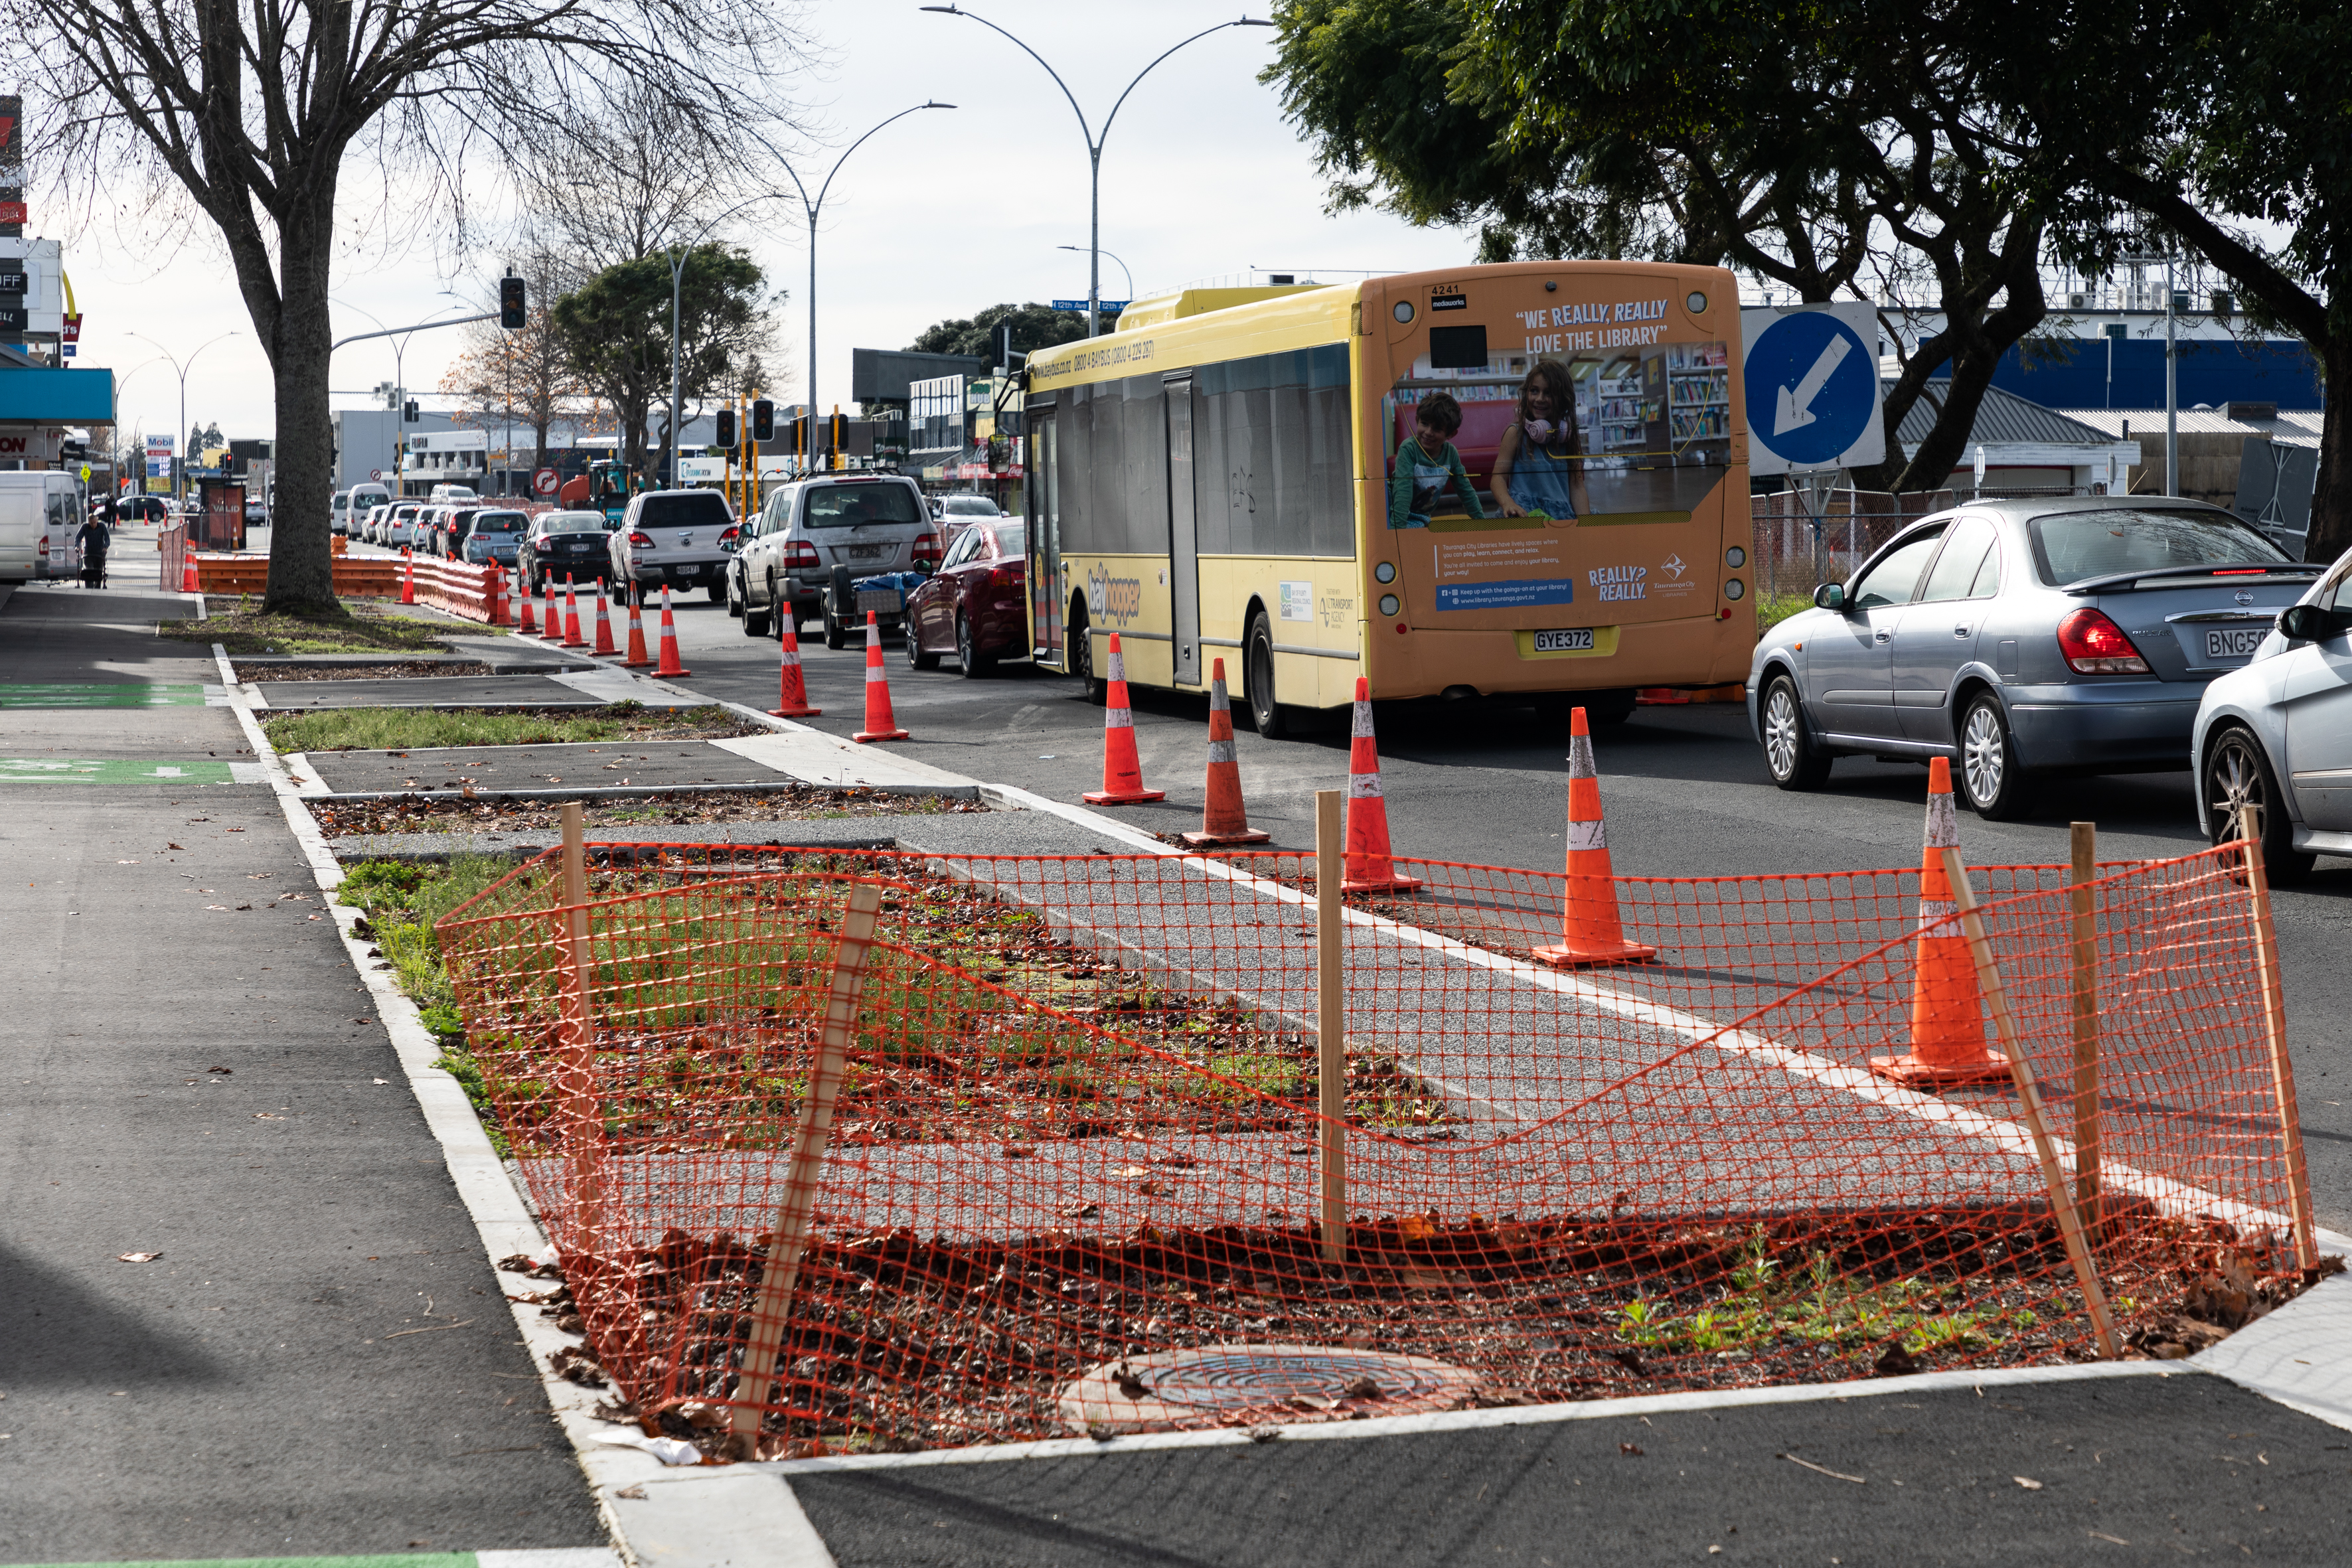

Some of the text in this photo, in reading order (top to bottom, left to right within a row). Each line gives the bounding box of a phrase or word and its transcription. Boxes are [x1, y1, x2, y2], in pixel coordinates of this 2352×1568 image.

[1432, 285, 1458, 295] 4241
[1516, 299, 1668, 329] “WE REALLY, REALLY
[1526, 325, 1668, 354] LOVE THE LIBRARY”
[1074, 353, 1087, 372] 0800
[1087, 353, 1091, 369] 4
[1091, 348, 1111, 369] BAYBUS
[1111, 345, 1127, 367] (0800
[1128, 344, 1131, 360] 4
[1132, 341, 1142, 361] 229
[1142, 340, 1154, 360] 287)
[970, 393, 990, 404] HUB
[1511, 540, 1525, 548] lively
[1526, 539, 1542, 548] spaces
[850, 548, 880, 558] CZF362
[1589, 566, 1648, 587] REALLY?
[1088, 568, 1140, 627] bayhopper
[1460, 595, 1535, 604] www.library.tauranga.govt.nz
[1599, 582, 1647, 602] REALLY.
[1537, 631, 1591, 648] GYE372
